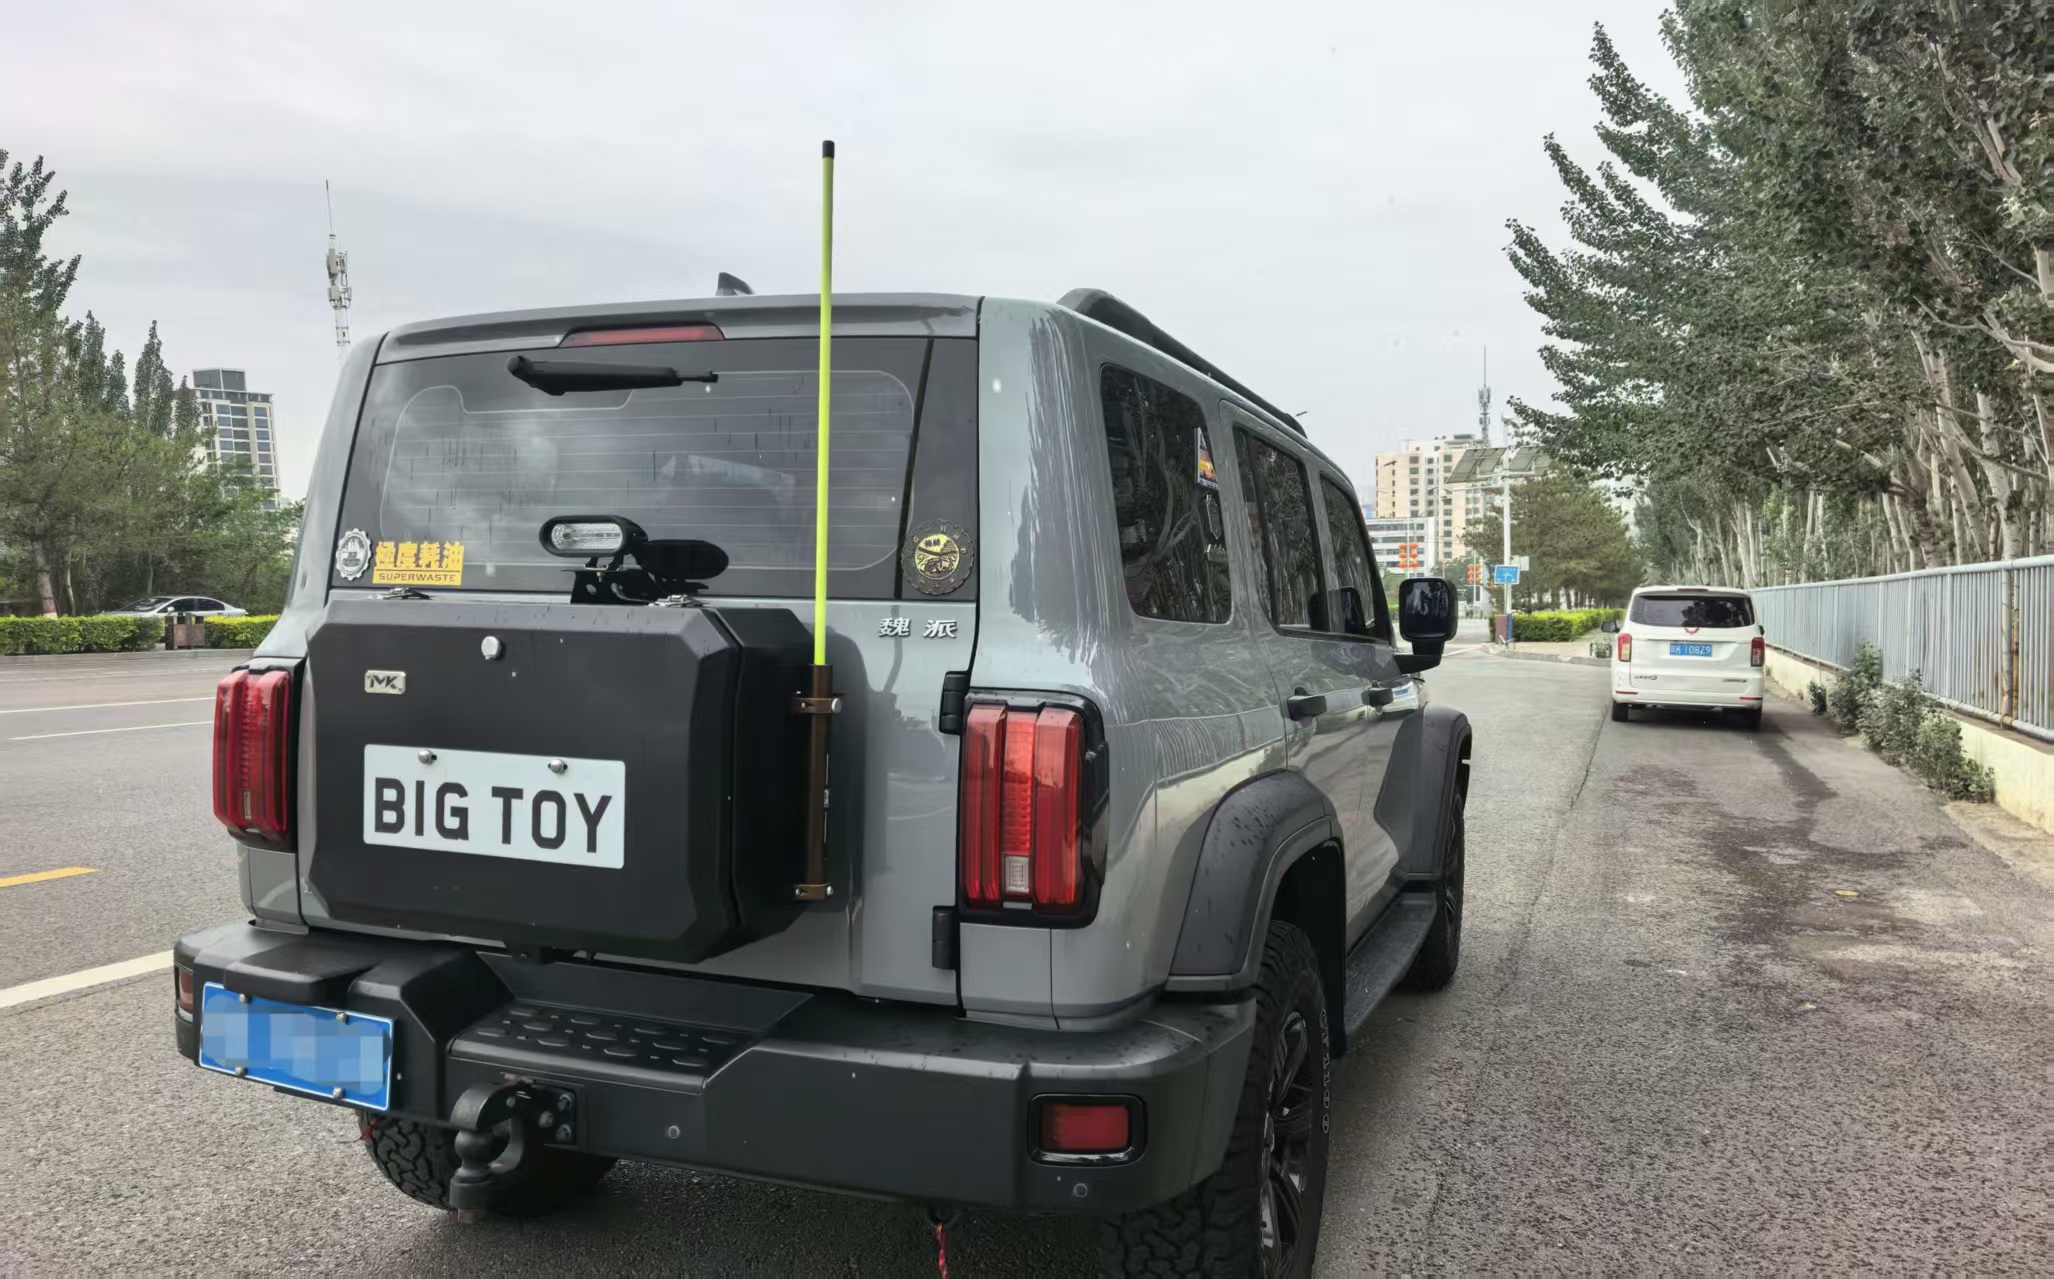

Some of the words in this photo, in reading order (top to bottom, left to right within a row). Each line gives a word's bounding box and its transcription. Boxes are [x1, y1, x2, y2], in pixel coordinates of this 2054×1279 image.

[378, 572, 457, 583] SUPERWASTE
[374, 777, 470, 841] BIG
[491, 786, 613, 853] TOY
